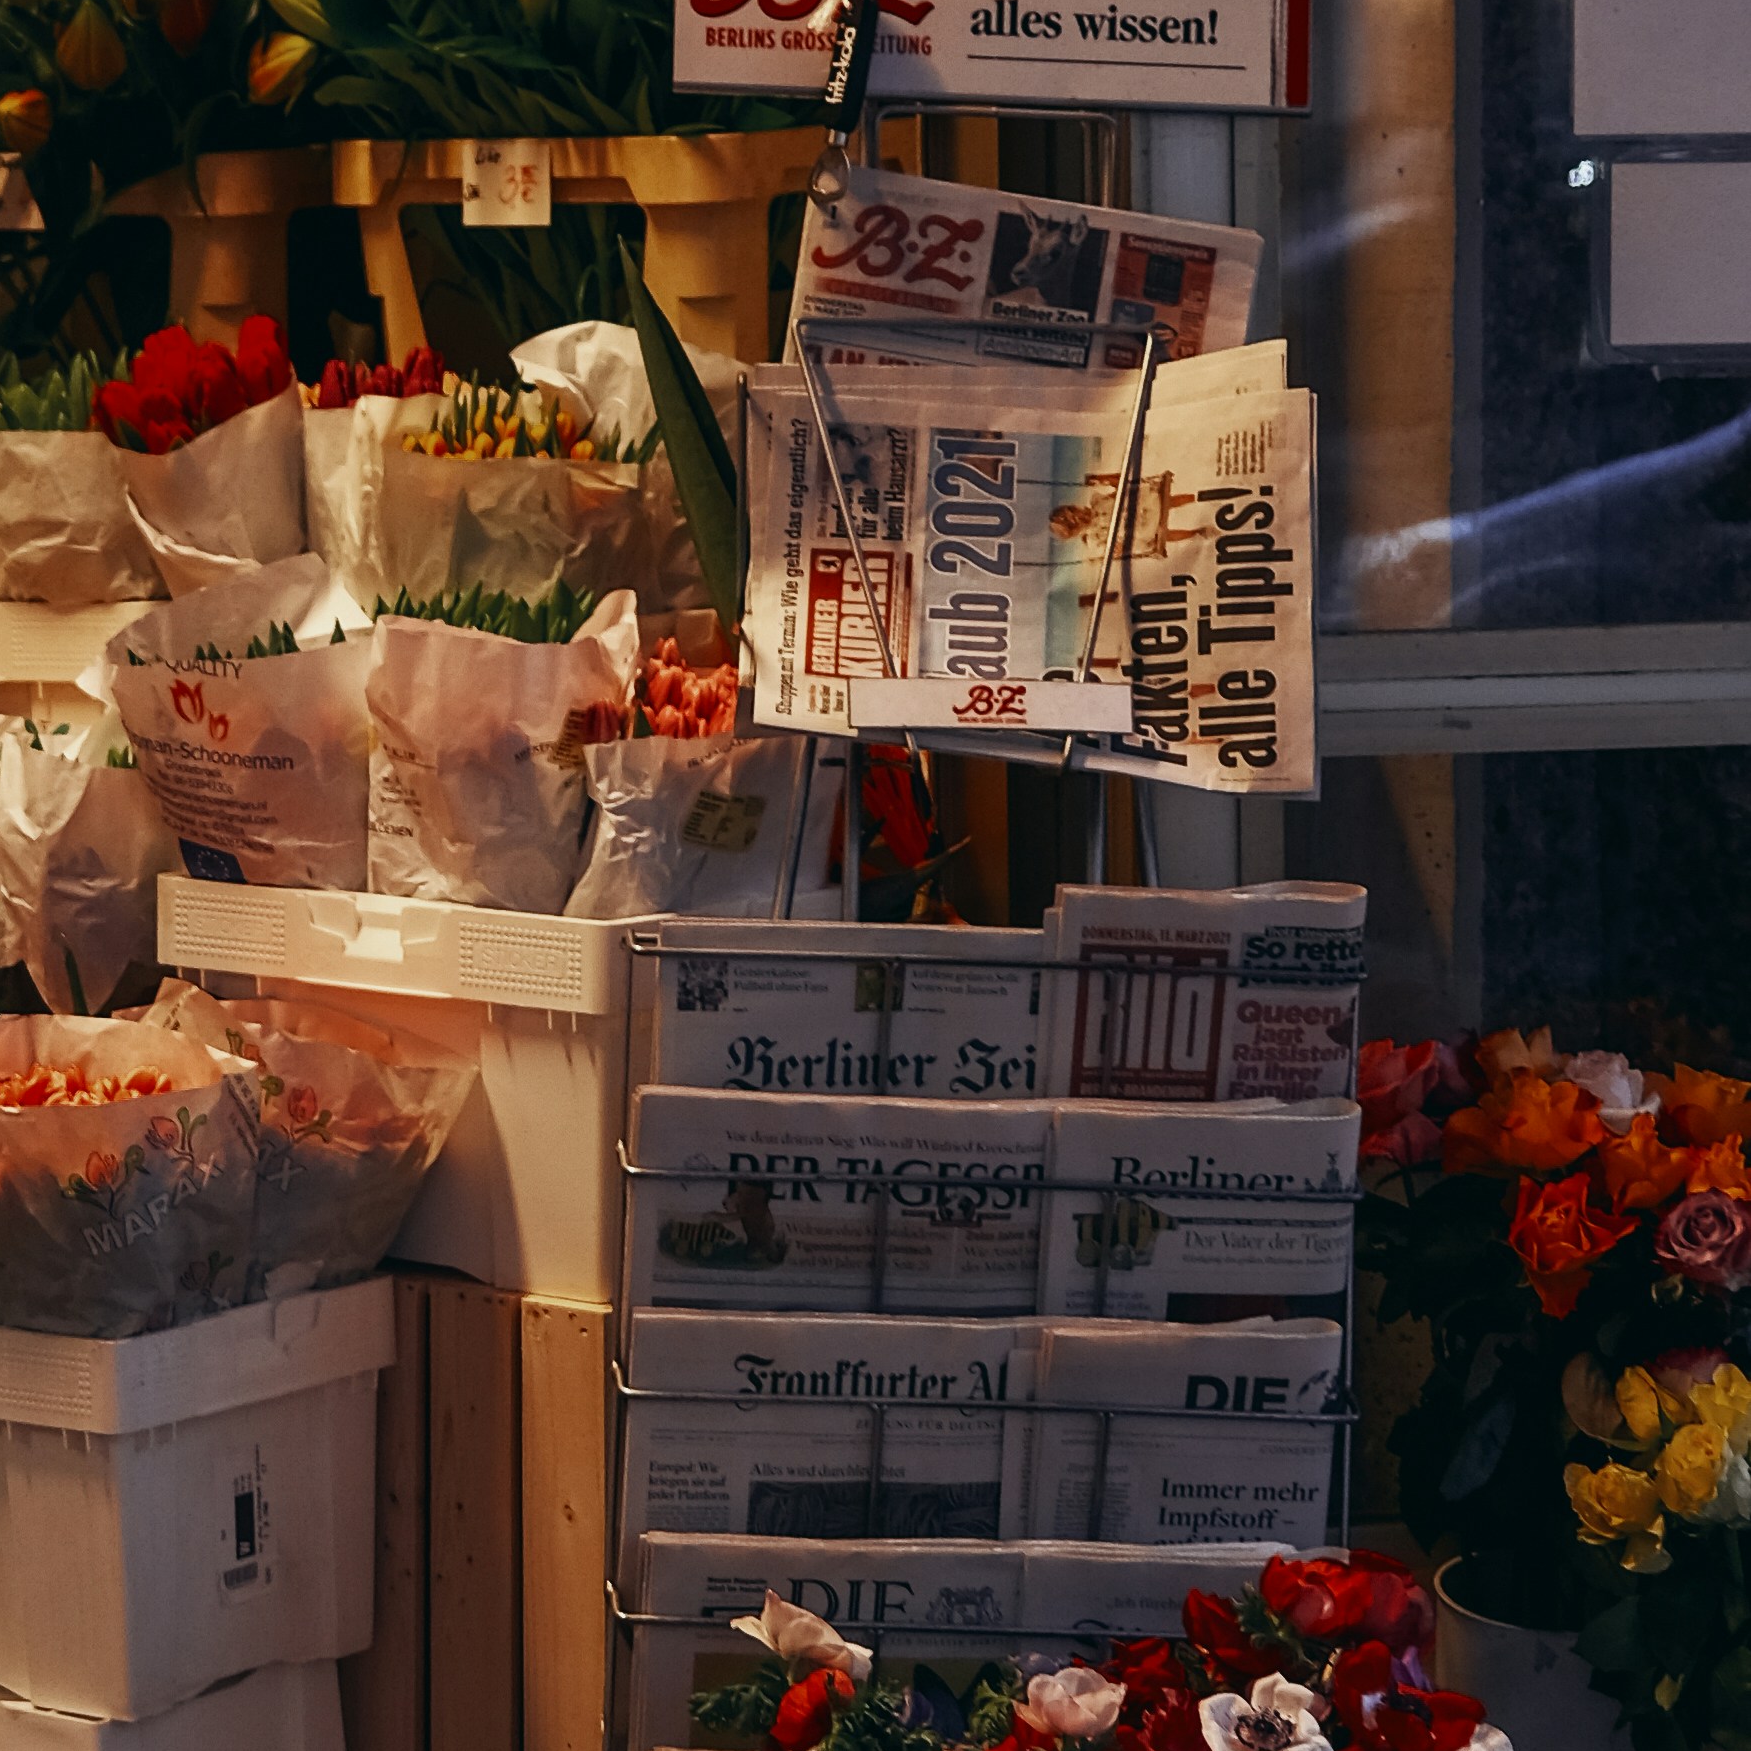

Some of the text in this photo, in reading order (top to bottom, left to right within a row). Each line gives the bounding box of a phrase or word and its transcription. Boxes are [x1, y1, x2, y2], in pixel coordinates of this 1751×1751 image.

[705, 26, 775, 49] BERLINS
[870, 33, 932, 56] EITUNG
[971, 0, 1219, 46] alles wissen!
[786, 417, 809, 509] eigentlich?
[881, 427, 908, 541] beim Hausarzt?
[784, 512, 802, 540] das
[856, 488, 880, 538] für alle
[929, 434, 1018, 578] 2021
[782, 543, 805, 578] geht
[1197, 484, 1294, 656] Tipps!
[780, 581, 799, 608] Wie
[837, 556, 889, 678] KURIER
[811, 598, 839, 674] BERLINER
[1109, 574, 1197, 768] Fakten,
[1197, 669, 1279, 769] alle
[1245, 936, 1286, 960] So
[1081, 952, 1218, 1072] BILD
[1235, 999, 1343, 1025] Queen
[1255, 1024, 1306, 1046] jagt
[723, 1035, 937, 1091] Berliner
[1237, 1061, 1324, 1081] in ihrer
[728, 1152, 822, 1202] DER
[1111, 1155, 1295, 1193] Berliner
[734, 1353, 958, 1410] Frankfurter
[1184, 1374, 1291, 1414] DIE
[1161, 1477, 1320, 1503] Immer mehr
[1157, 1506, 1281, 1534] Impfstoff
[787, 1577, 916, 1623] DIE
